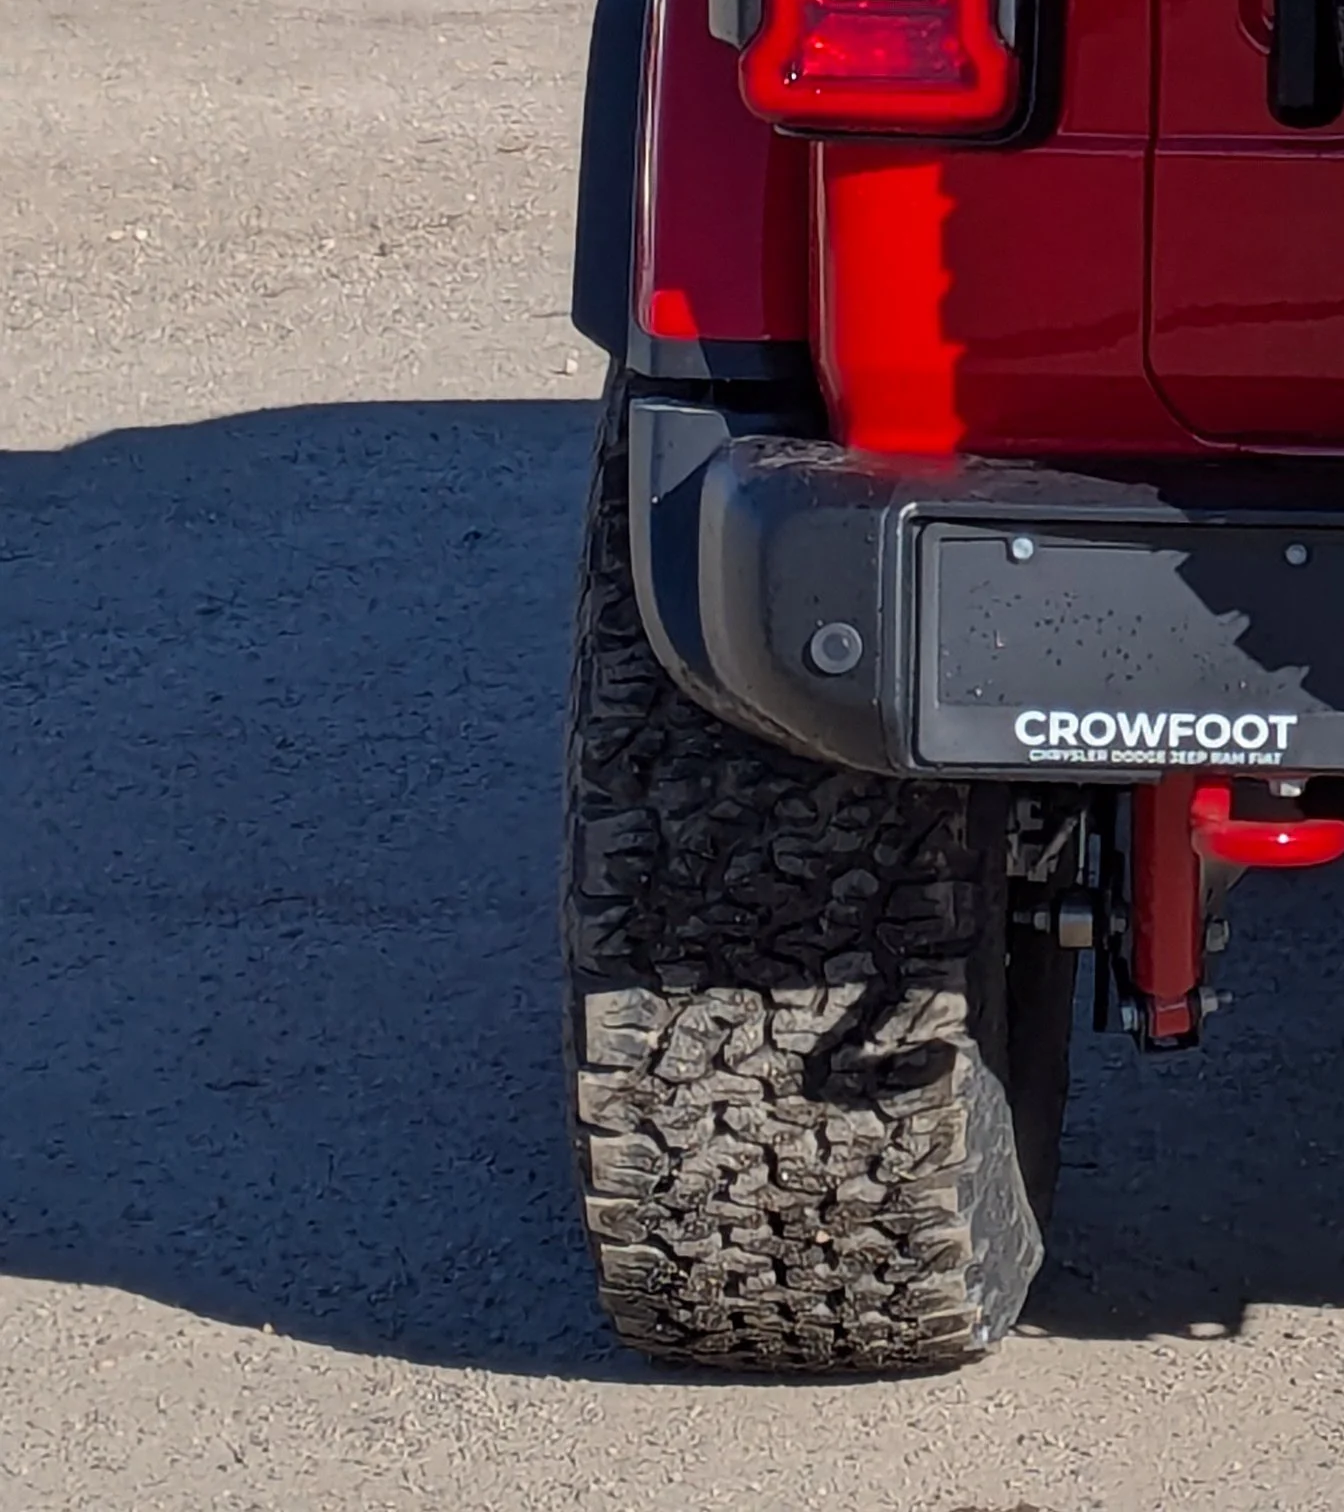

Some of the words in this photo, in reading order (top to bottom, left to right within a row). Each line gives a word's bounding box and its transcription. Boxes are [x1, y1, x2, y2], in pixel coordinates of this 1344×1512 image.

[1014, 710, 1298, 749] CROWFOOT
[1028, 748, 1108, 763] CHRYSLER
[1111, 749, 1166, 764] DODGE
[1210, 751, 1245, 765] RAM
[1249, 752, 1284, 766] FIAT
